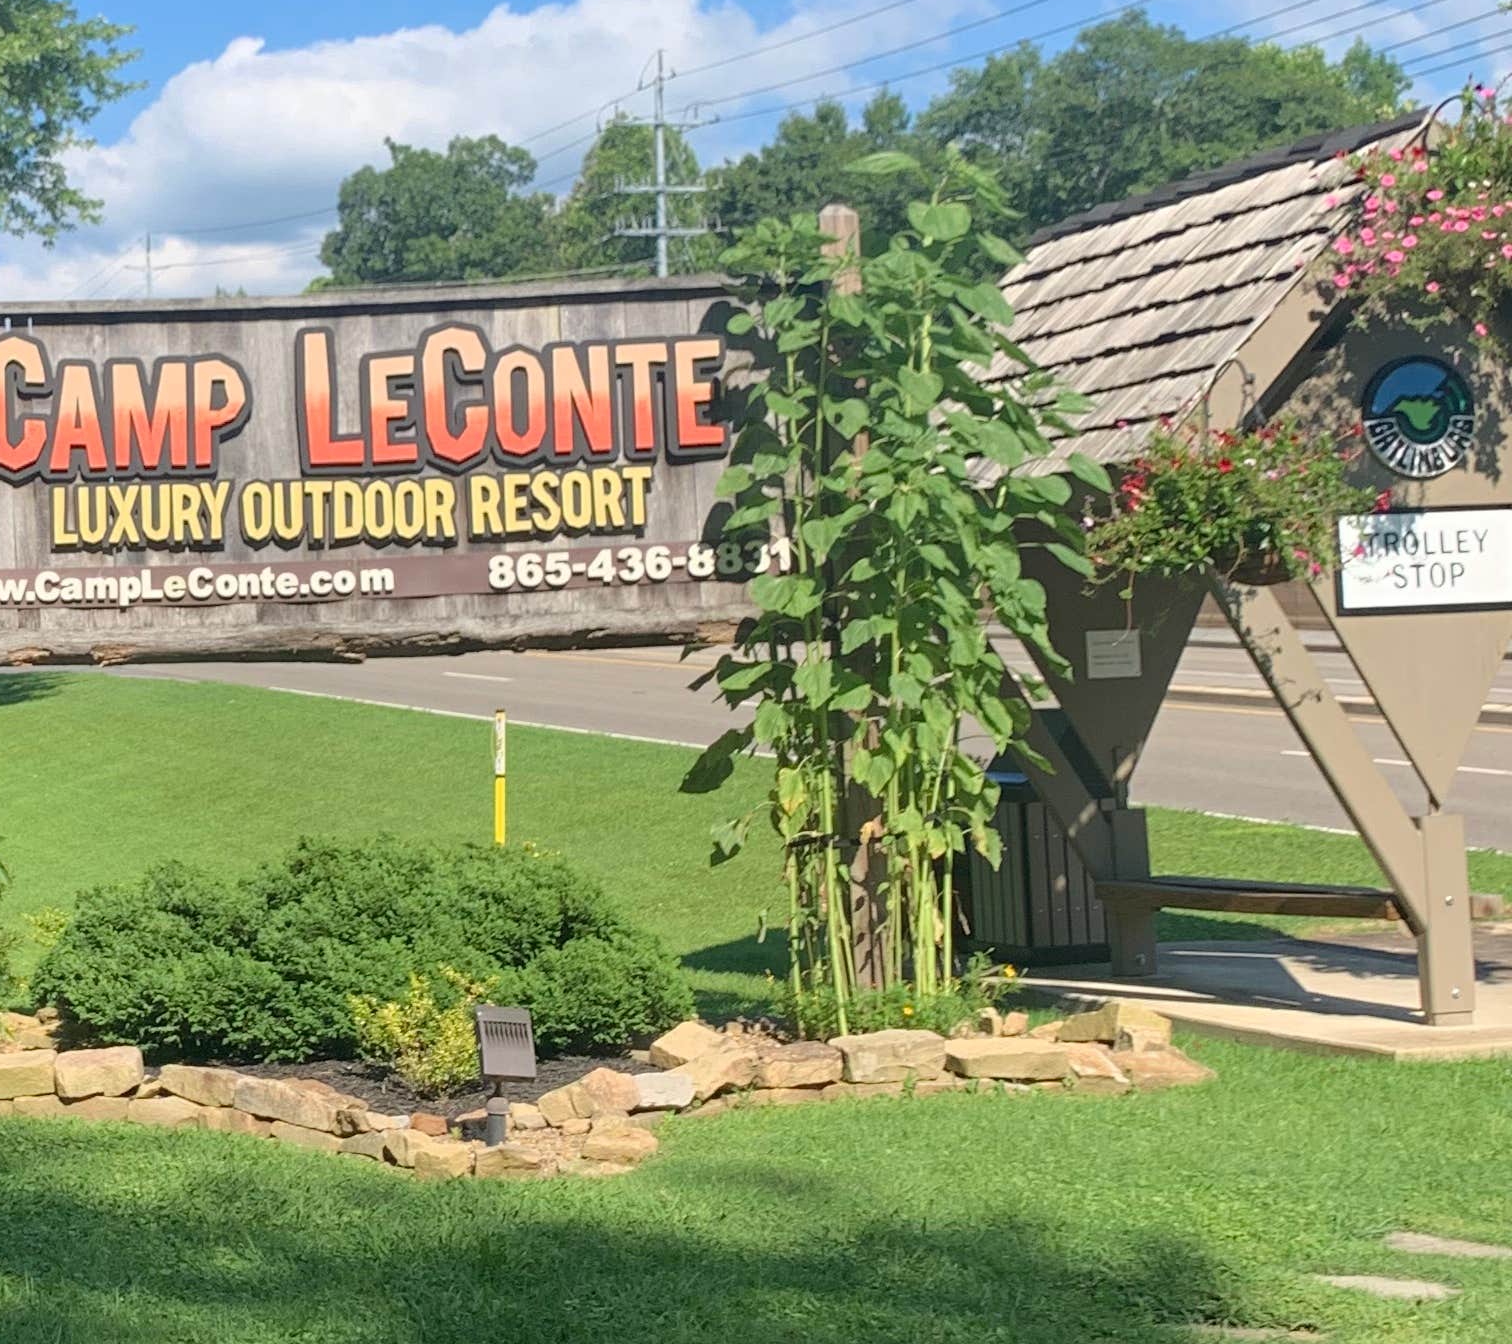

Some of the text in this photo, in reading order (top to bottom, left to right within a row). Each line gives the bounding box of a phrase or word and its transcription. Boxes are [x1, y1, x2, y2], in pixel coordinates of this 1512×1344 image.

[51, 465, 652, 548] LUXURY OUTDOOR RESORT
[488, 536, 793, 591] 865-436-8831
[1367, 528, 1490, 558] TROLLEY
[1392, 561, 1466, 590] STOP
